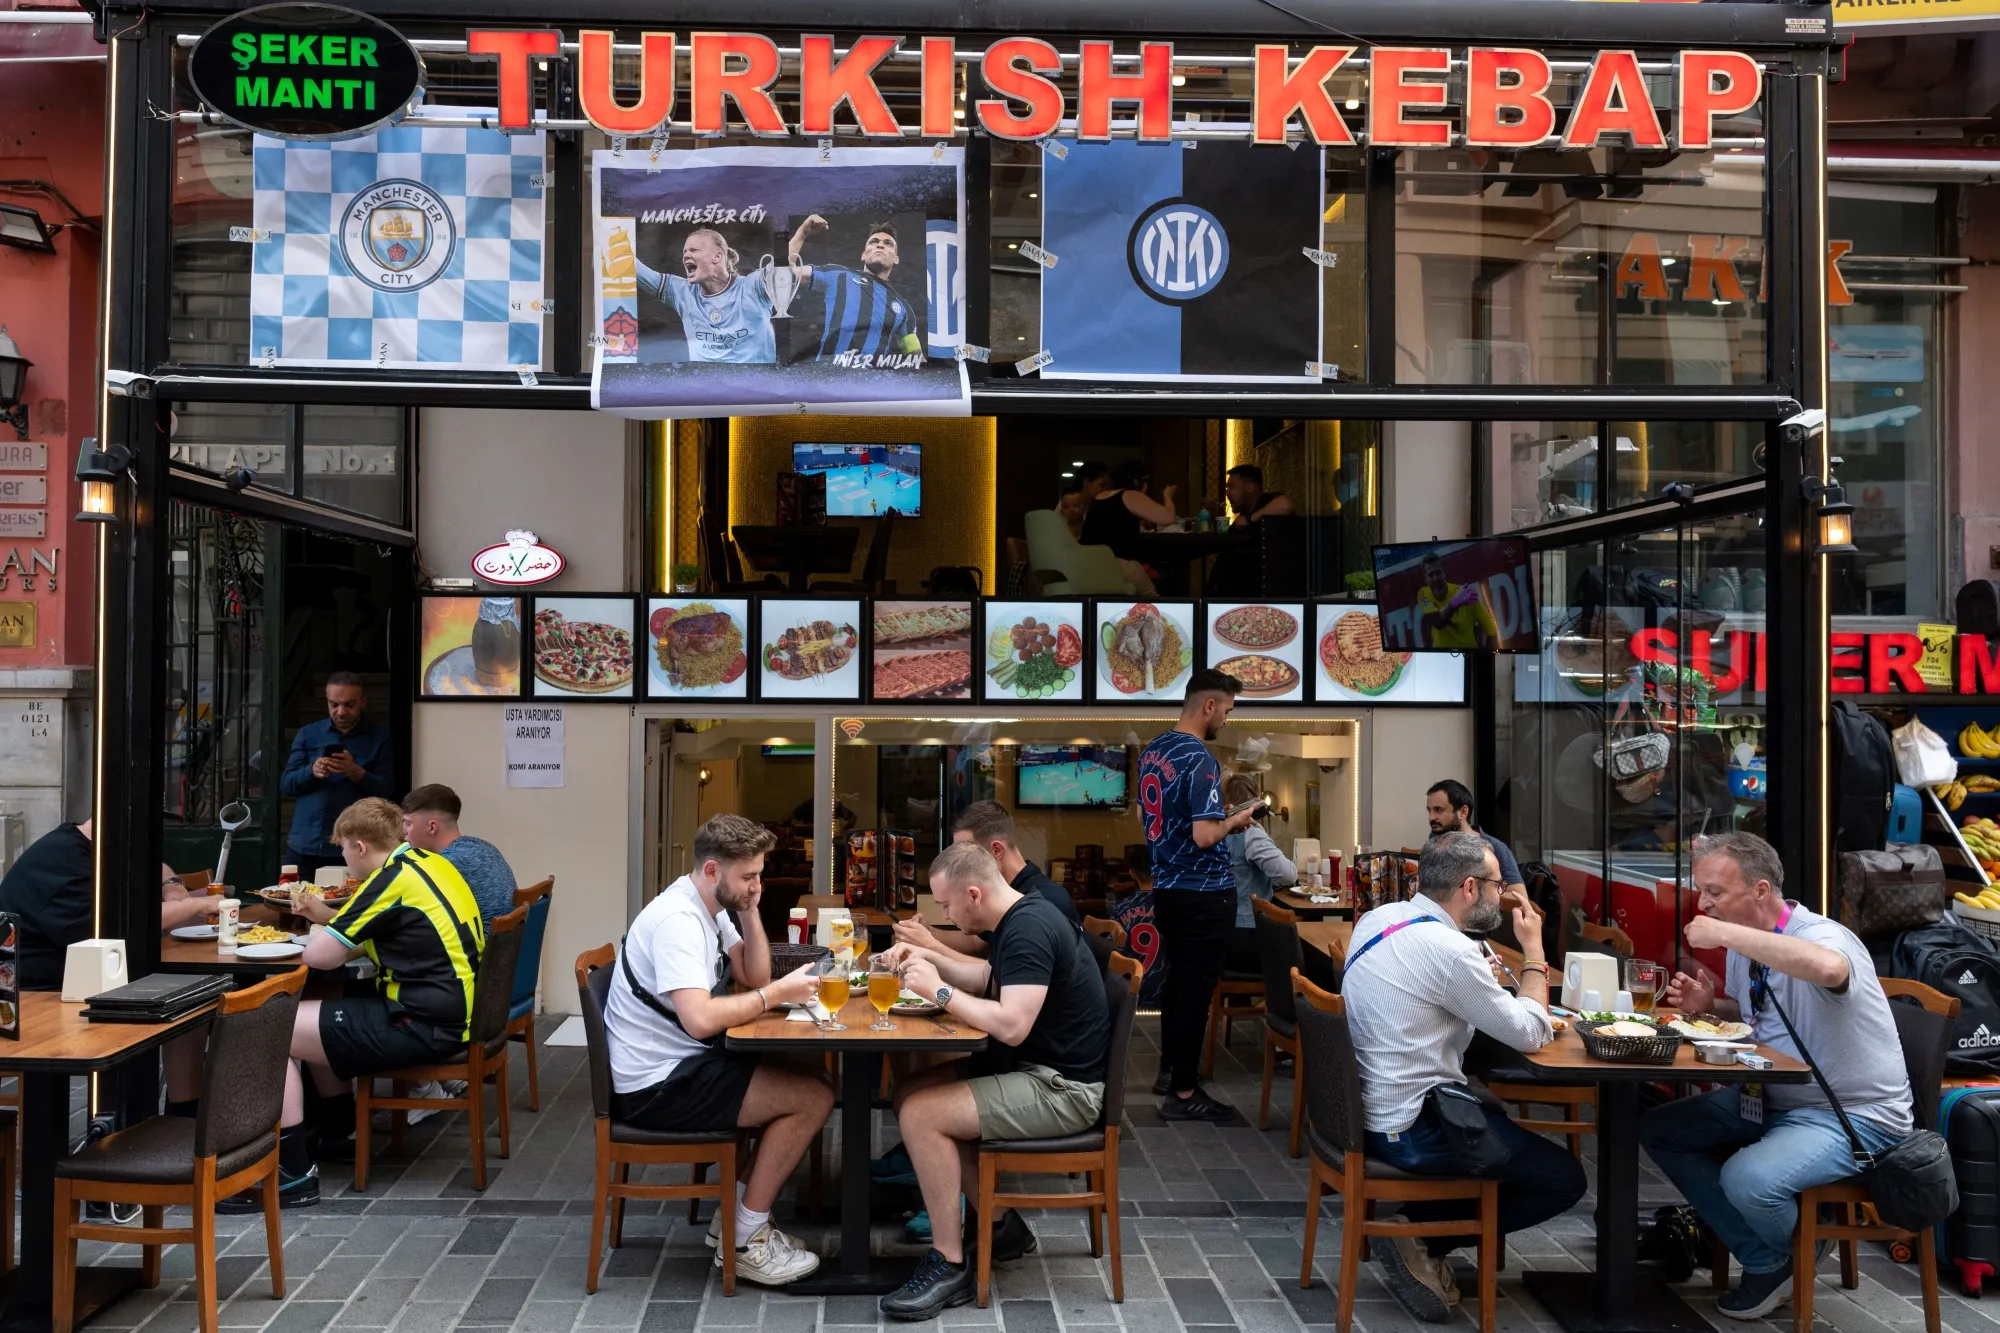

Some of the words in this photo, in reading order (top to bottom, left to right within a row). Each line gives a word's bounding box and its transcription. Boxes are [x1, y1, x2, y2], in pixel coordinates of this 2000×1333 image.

[231, 32, 380, 71] ŞEKER
[235, 76, 376, 111] MANTI
[466, 28, 1174, 142] TURKISH
[1252, 44, 1763, 149] KEBAP
[353, 187, 443, 223] MANCHESTER
[640, 203, 737, 225] MANCHESTER
[739, 203, 768, 225] CITY
[380, 273, 414, 285] CITY
[695, 328, 749, 344] ETIHAD
[832, 347, 873, 370] INTER
[876, 352, 926, 370] MILAN
[28, 701, 43, 711] BE
[505, 708, 523, 721] USTA
[524, 708, 563, 722] YARDIMCISI
[515, 726, 551, 739] ARANIYOR
[527, 763, 561, 771] ARANIYOR
[1140, 772, 1164, 842] 9
[1130, 922, 1160, 975] 9
